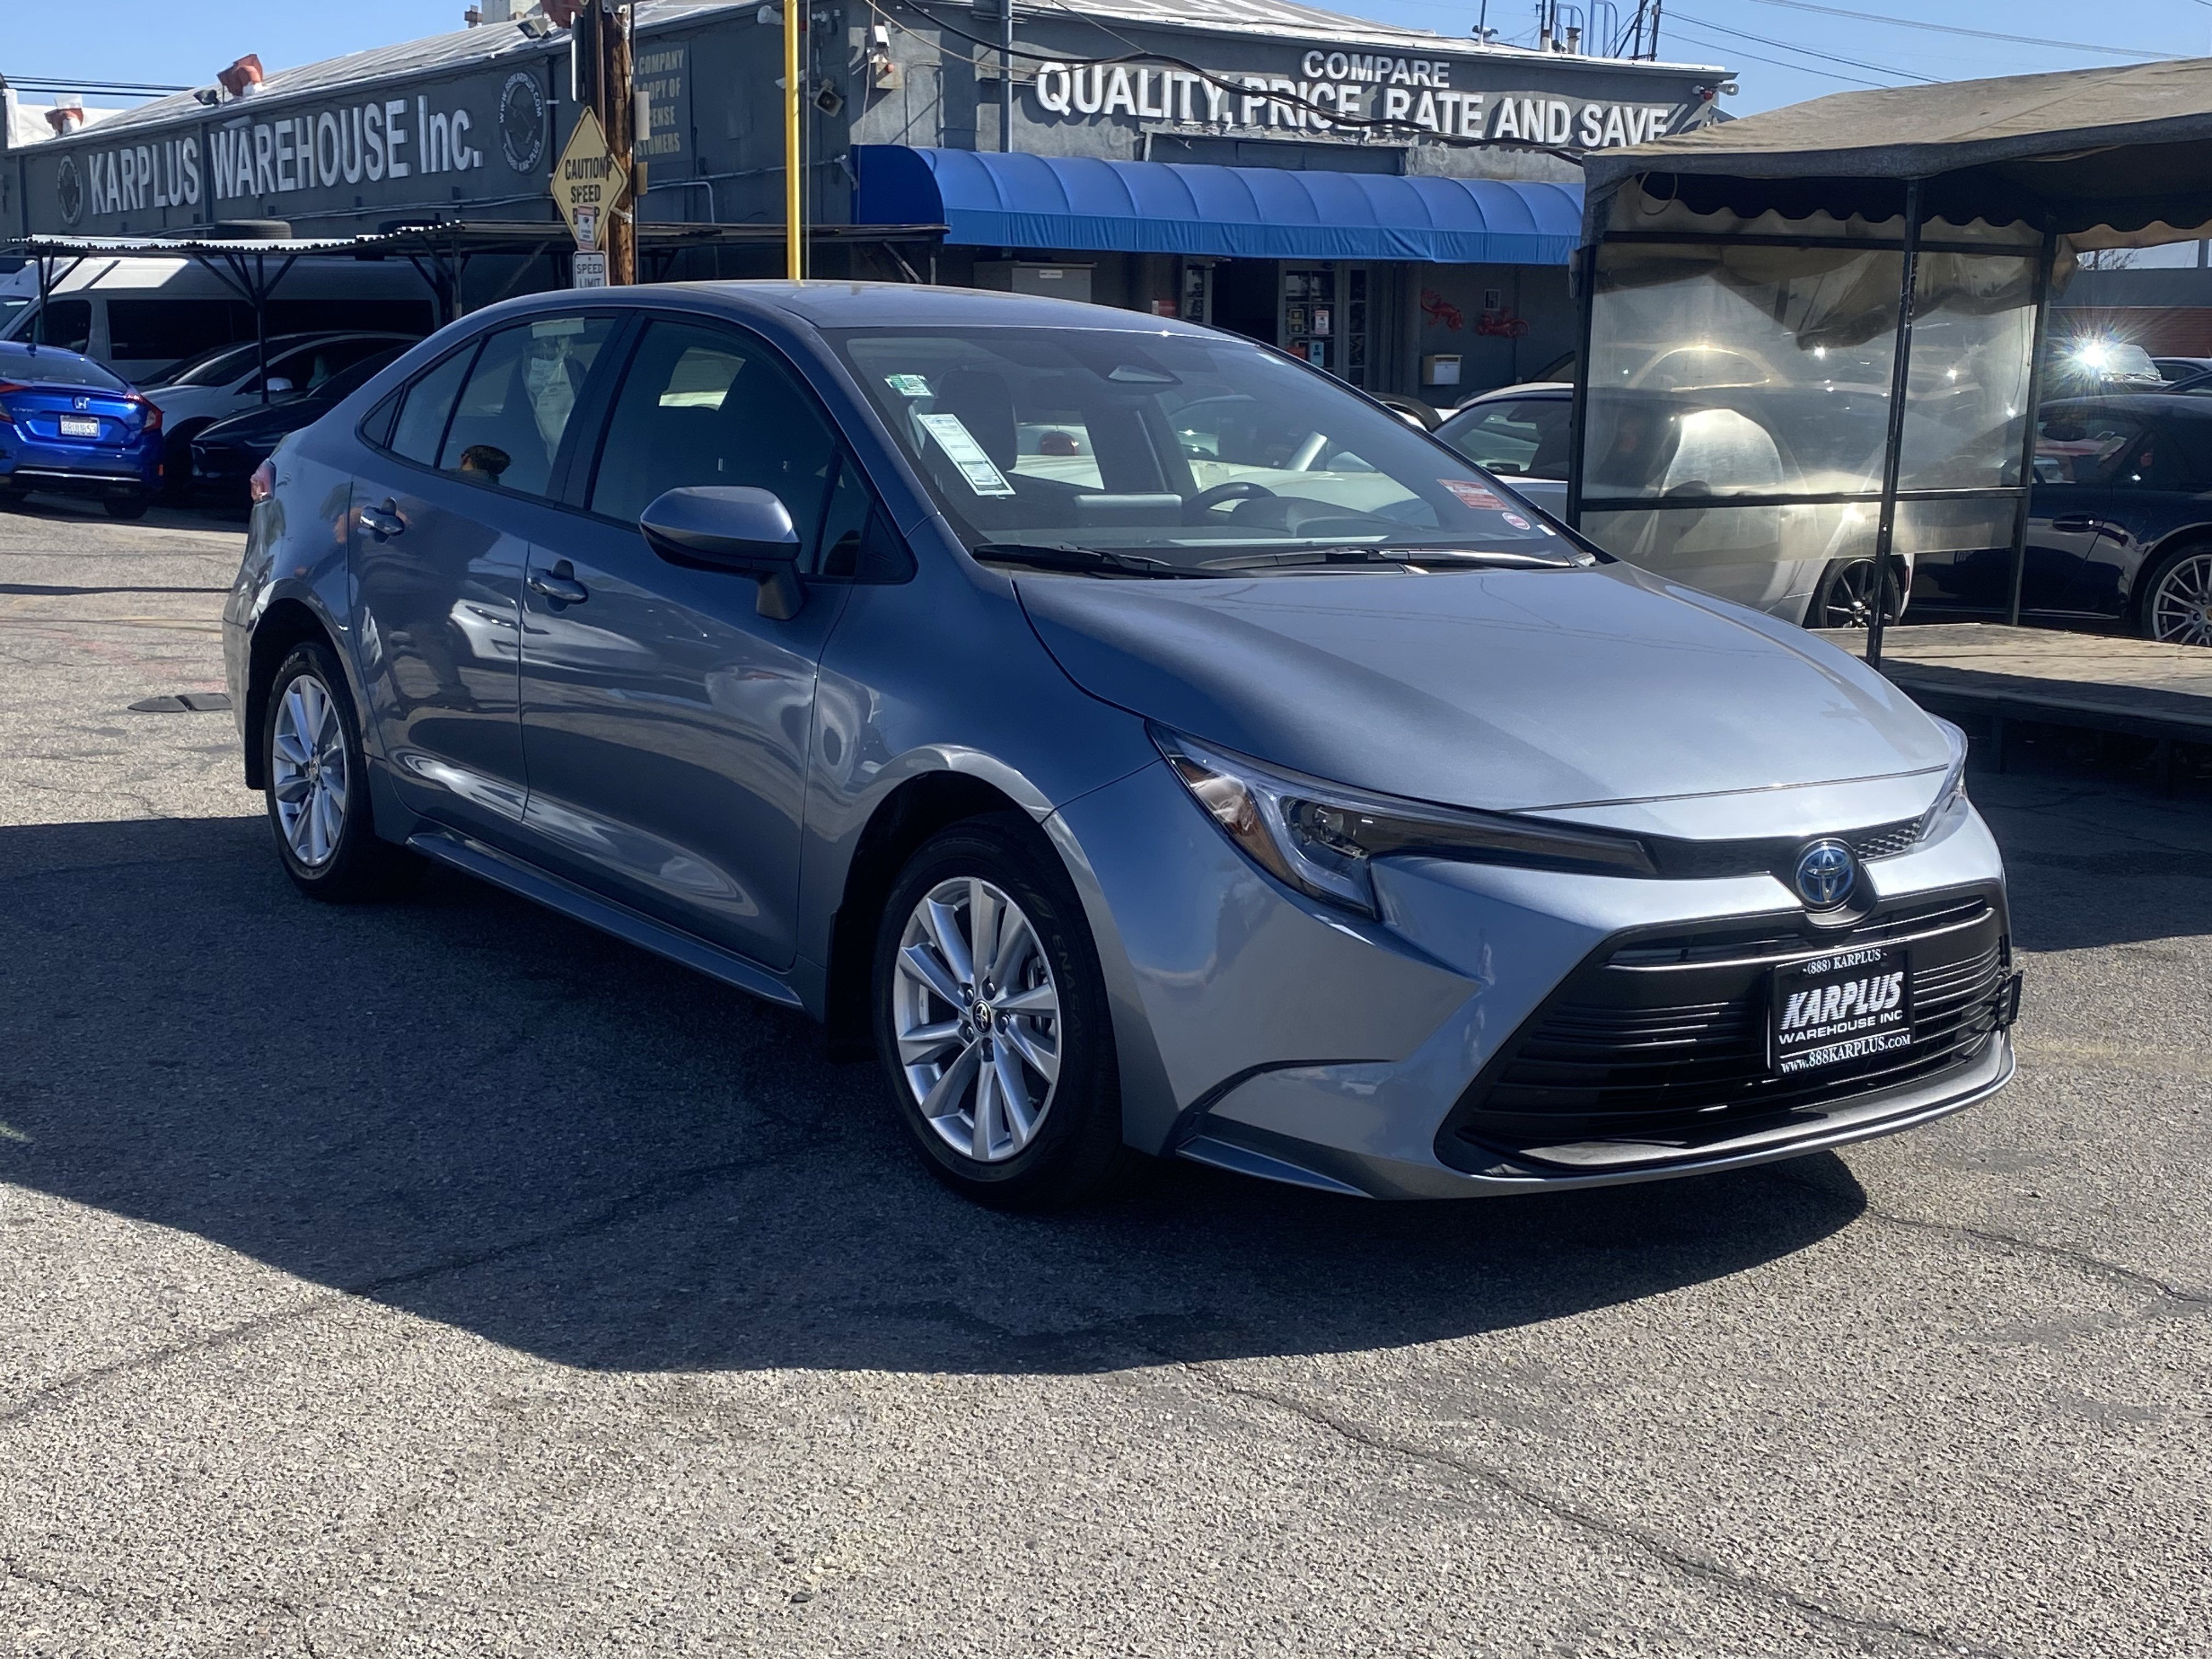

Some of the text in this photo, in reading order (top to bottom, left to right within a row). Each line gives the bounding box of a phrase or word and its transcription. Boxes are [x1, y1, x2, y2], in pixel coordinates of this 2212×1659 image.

[639, 49, 684, 75] COMPANY
[1301, 50, 1450, 88] COMPARE
[669, 77, 681, 98] OF
[1036, 61, 1233, 131] QUALITY,
[1384, 88, 1483, 138] RATE
[1493, 98, 1571, 144] AND
[1578, 104, 1669, 148] SAVE
[88, 137, 201, 215] KARPLUS
[210, 99, 411, 199] WAREHOUSE
[417, 95, 484, 174] Inc.
[565, 156, 607, 180] CAUTION
[571, 184, 601, 203] SPEED
[577, 264, 603, 274] SPEED
[579, 278, 601, 289] LIMIT
[1807, 949, 1881, 974] (888) KARPLUS
[1779, 972, 1904, 1030] KARPLUS
[1779, 1009, 1903, 1045] WAREHOUSE INC
